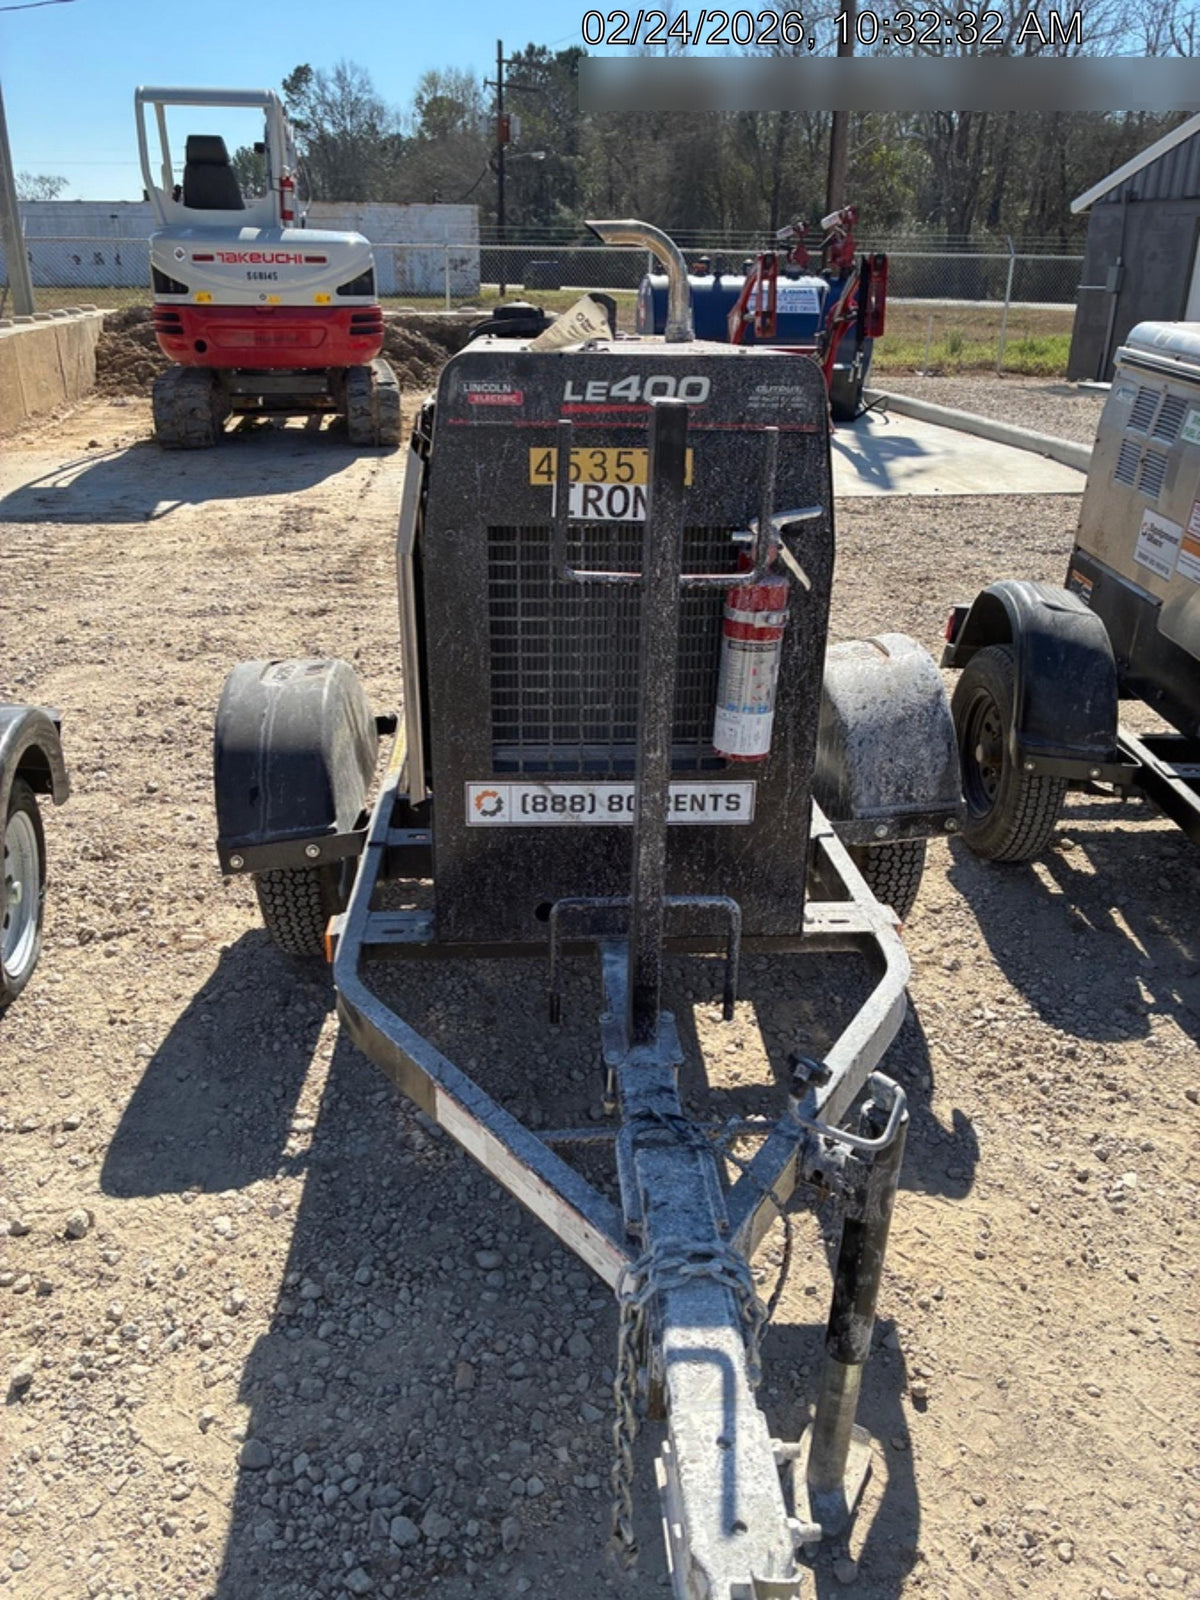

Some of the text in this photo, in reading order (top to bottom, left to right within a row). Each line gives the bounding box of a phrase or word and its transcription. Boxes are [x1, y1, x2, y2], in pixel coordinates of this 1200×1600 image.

[216, 252, 303, 264] TAKEUCHI
[463, 383, 512, 392] LINCOLN
[563, 374, 711, 405] LE400
[520, 793, 596, 813] (888)
